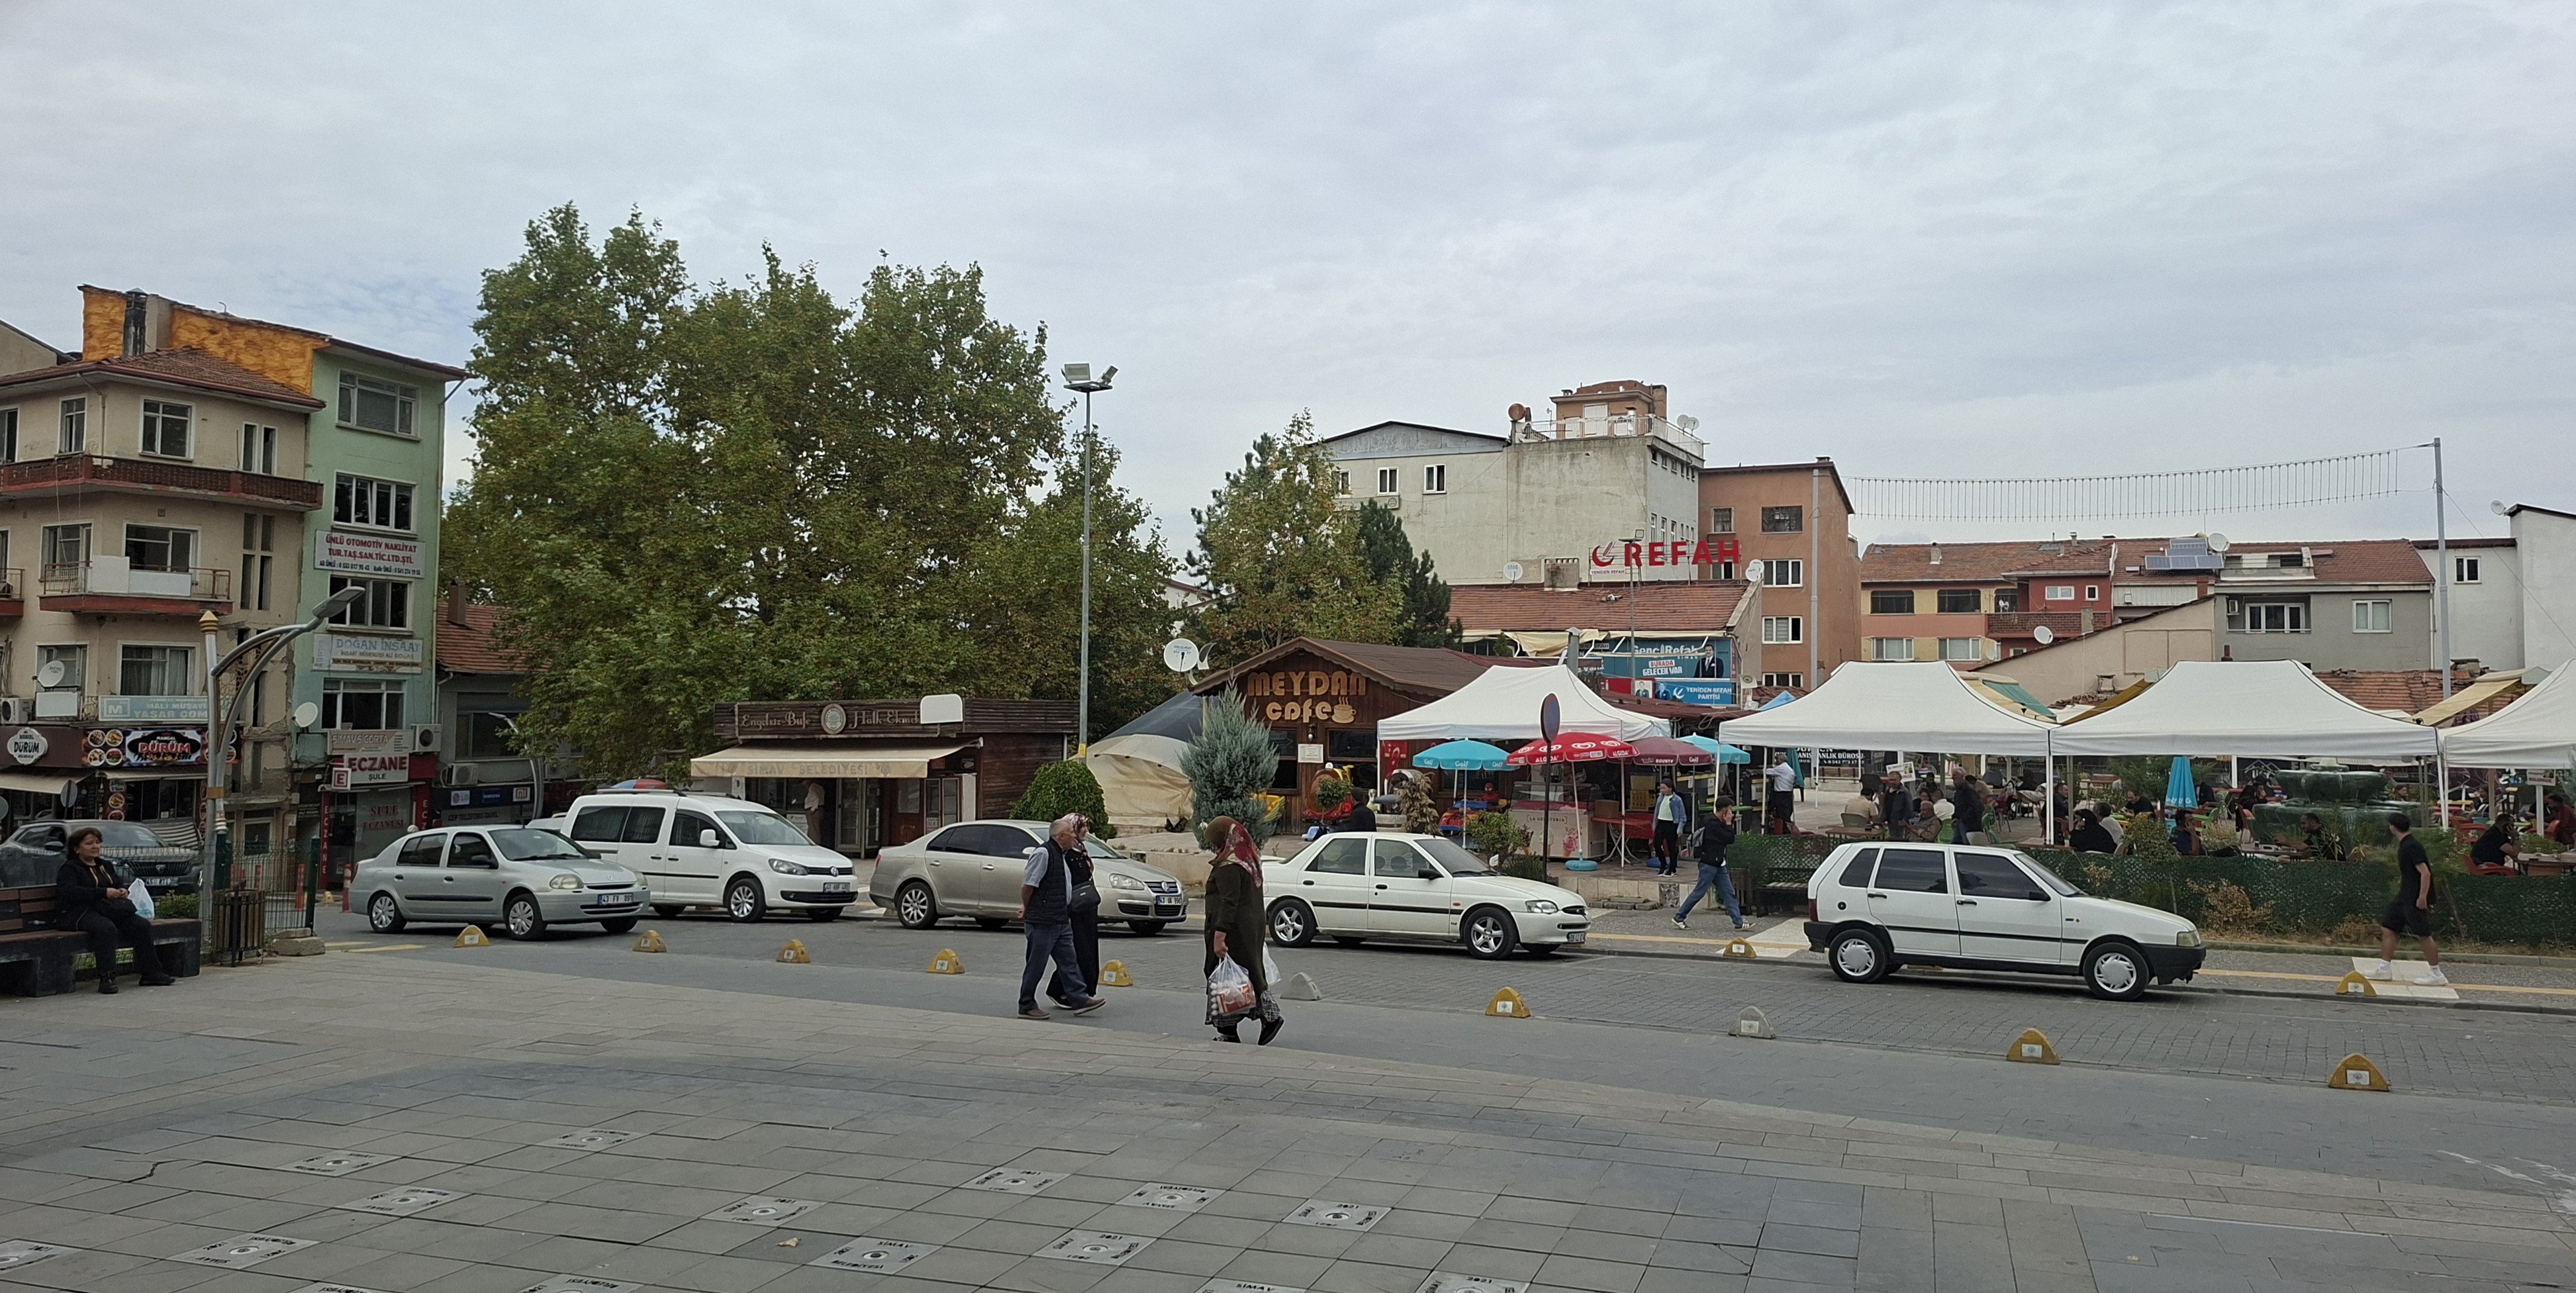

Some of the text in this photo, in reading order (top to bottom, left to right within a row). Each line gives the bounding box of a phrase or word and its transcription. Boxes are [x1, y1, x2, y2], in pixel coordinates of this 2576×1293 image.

[326, 534, 417, 553] ÜNLÜ OTOMOTİV NAKLİYAT
[1624, 540, 1739, 567] REFAH
[1643, 667, 1668, 676] GELECEK
[1247, 671, 1366, 696] MEYDAN
[849, 710, 882, 729] Halk
[14, 742, 39, 753] DÜRÜM
[138, 740, 191, 753] DÜRÜM
[348, 757, 407, 771] ECZANE
[337, 774, 344, 784] E
